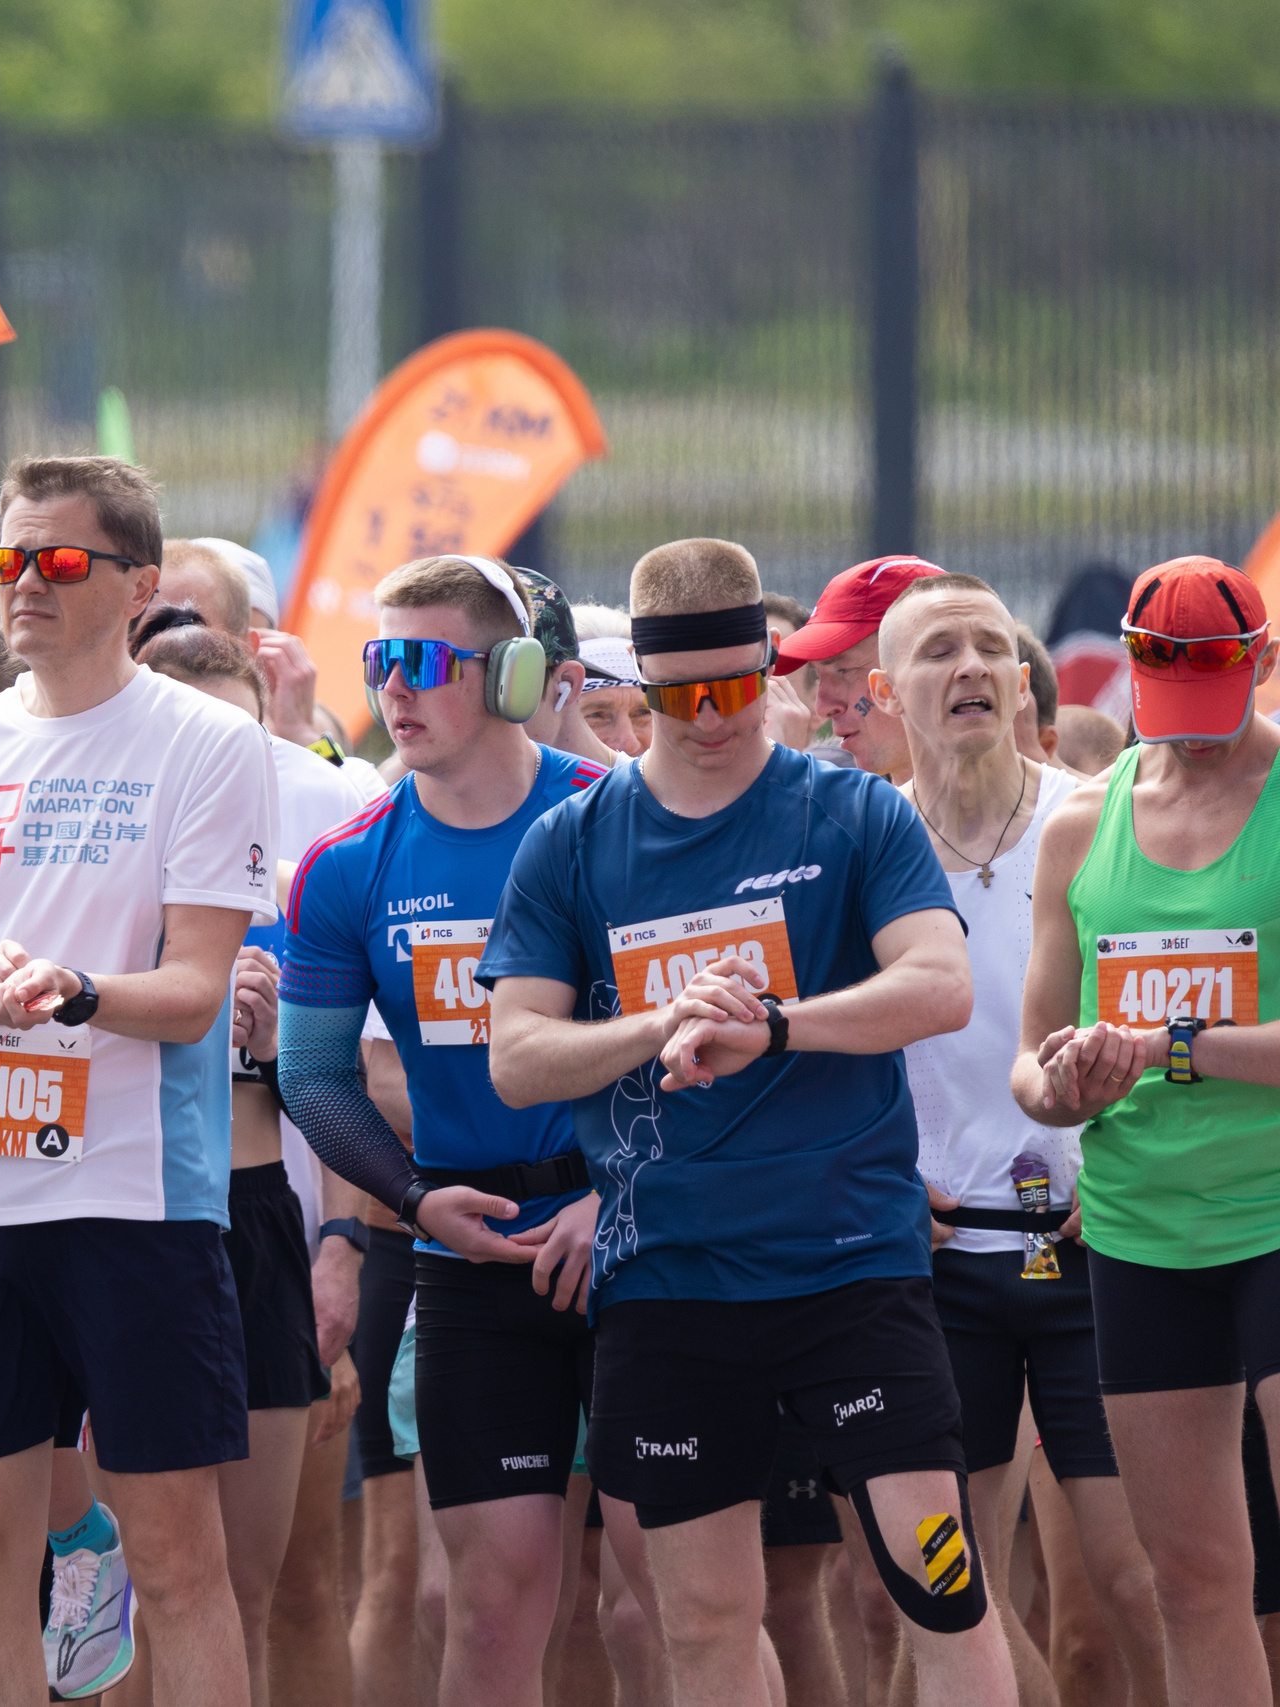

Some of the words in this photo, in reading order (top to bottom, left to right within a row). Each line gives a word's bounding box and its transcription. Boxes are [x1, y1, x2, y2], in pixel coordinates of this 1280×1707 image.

[29, 778, 87, 795] CHINA
[93, 779, 154, 798] COAST
[26, 798, 134, 815] MARATHON
[23, 820, 147, 842] 中國沿岸
[21, 844, 110, 866] 馬拉松
[734, 864, 822, 895] FESCO
[388, 893, 454, 916] LUKOIL
[433, 929, 453, 938] ПСБ
[634, 929, 657, 942] ПСБ
[1118, 941, 1137, 950] ПСБ
[1119, 967, 1232, 1022] 40271
[41, 1129, 63, 1150] A
[501, 1454, 550, 1471] PUNCHER
